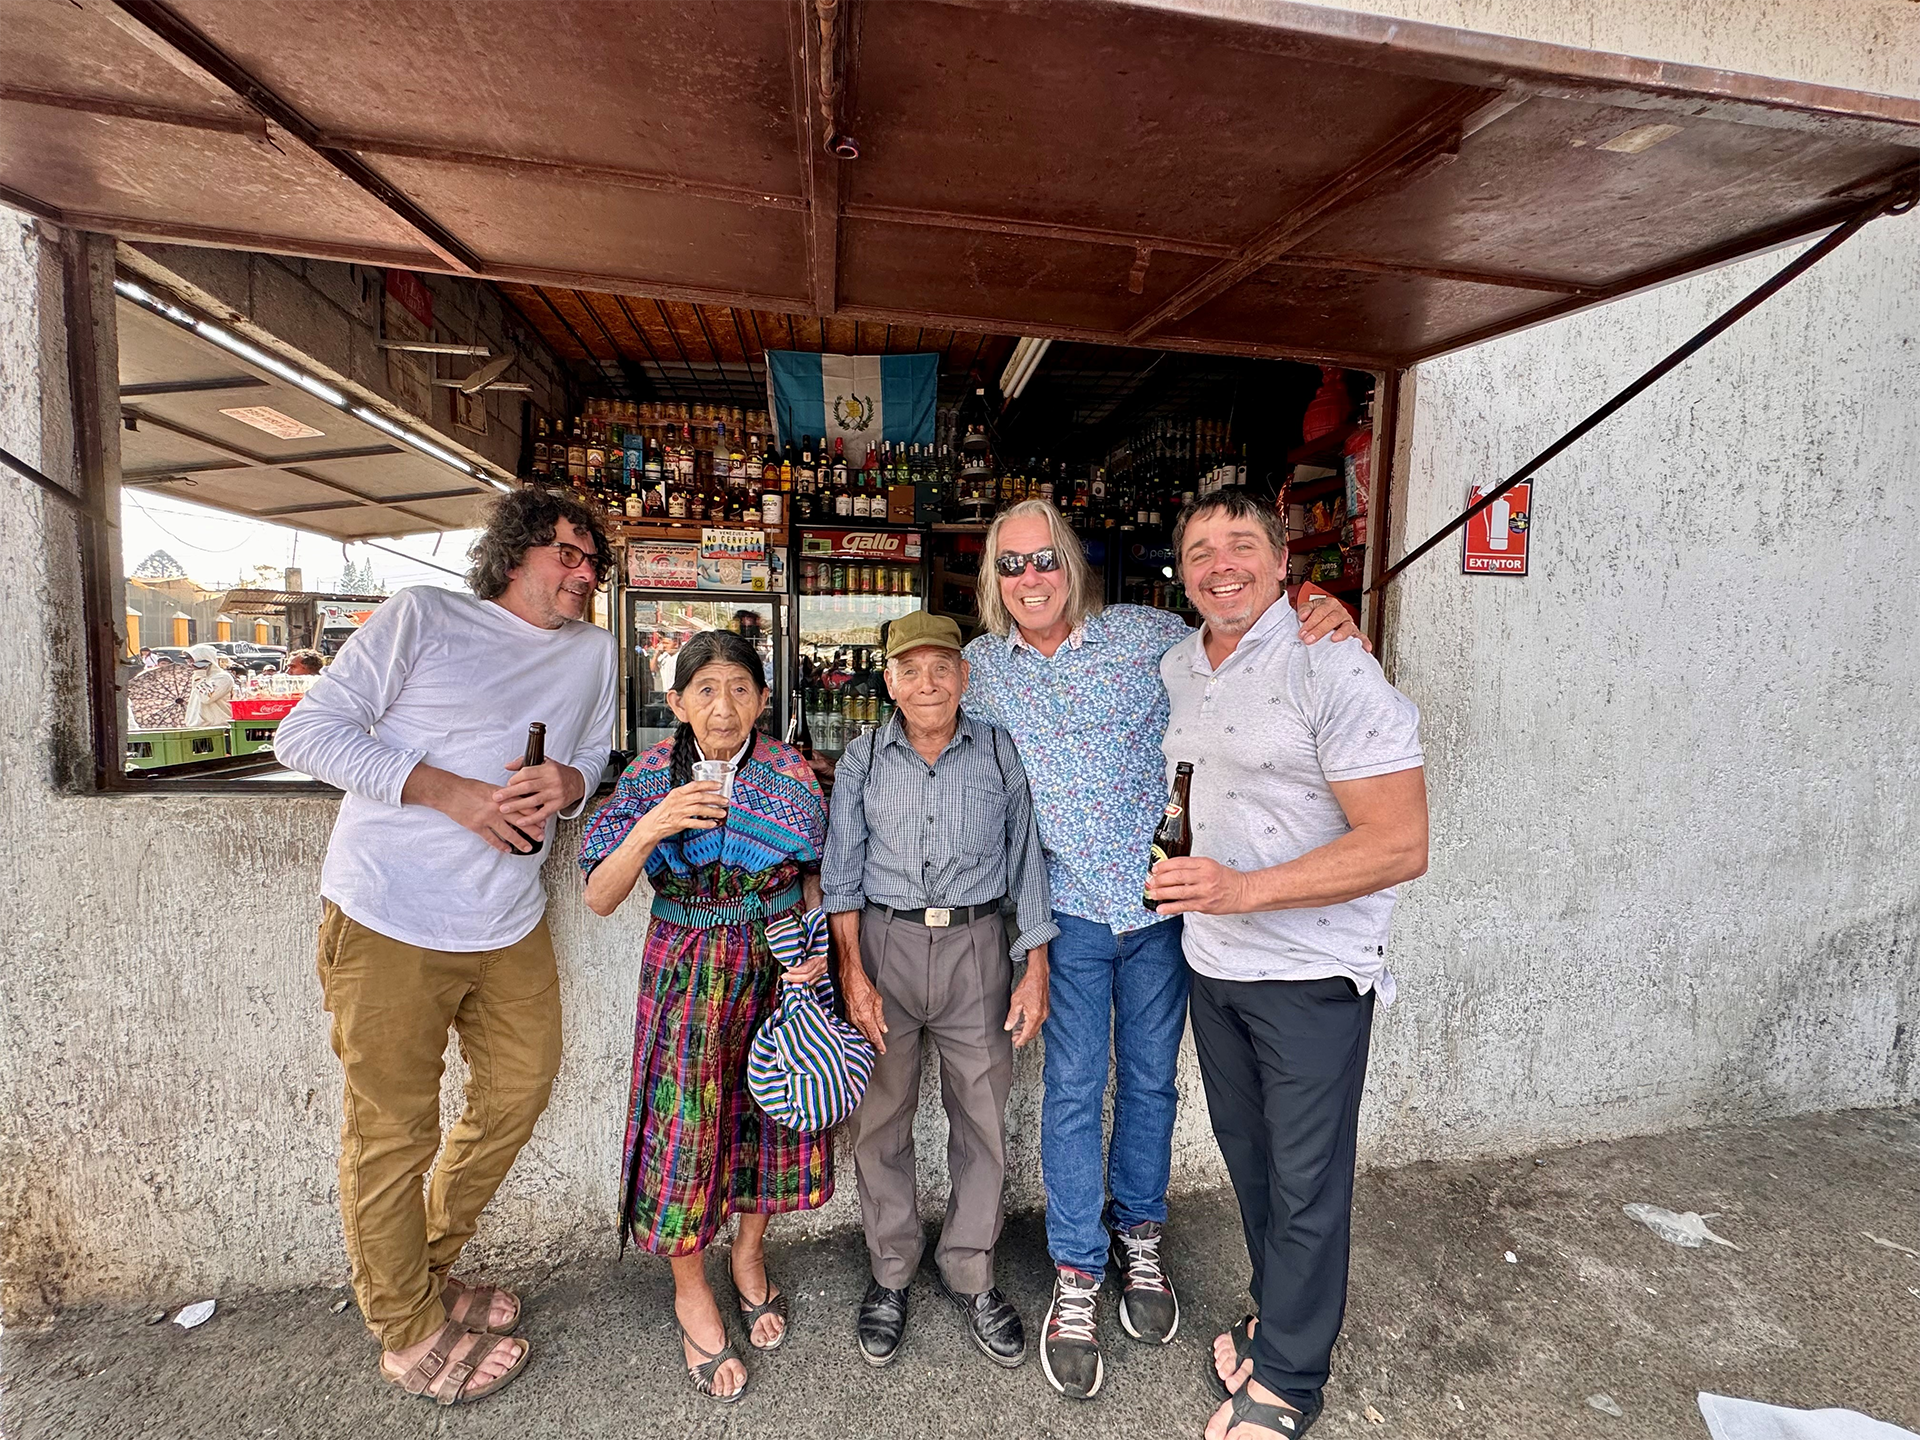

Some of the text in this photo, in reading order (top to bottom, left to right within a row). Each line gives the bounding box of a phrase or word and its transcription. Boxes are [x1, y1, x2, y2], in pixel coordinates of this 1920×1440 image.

[707, 535, 760, 545] NO CERVEZA
[842, 532, 899, 554] Gallo
[704, 543, 762, 553] NO TRABAJO
[1150, 549, 1175, 560] peps
[1469, 558, 1521, 569] EXTINTOR
[632, 578, 651, 586] NO
[654, 579, 697, 588] FUMAR
